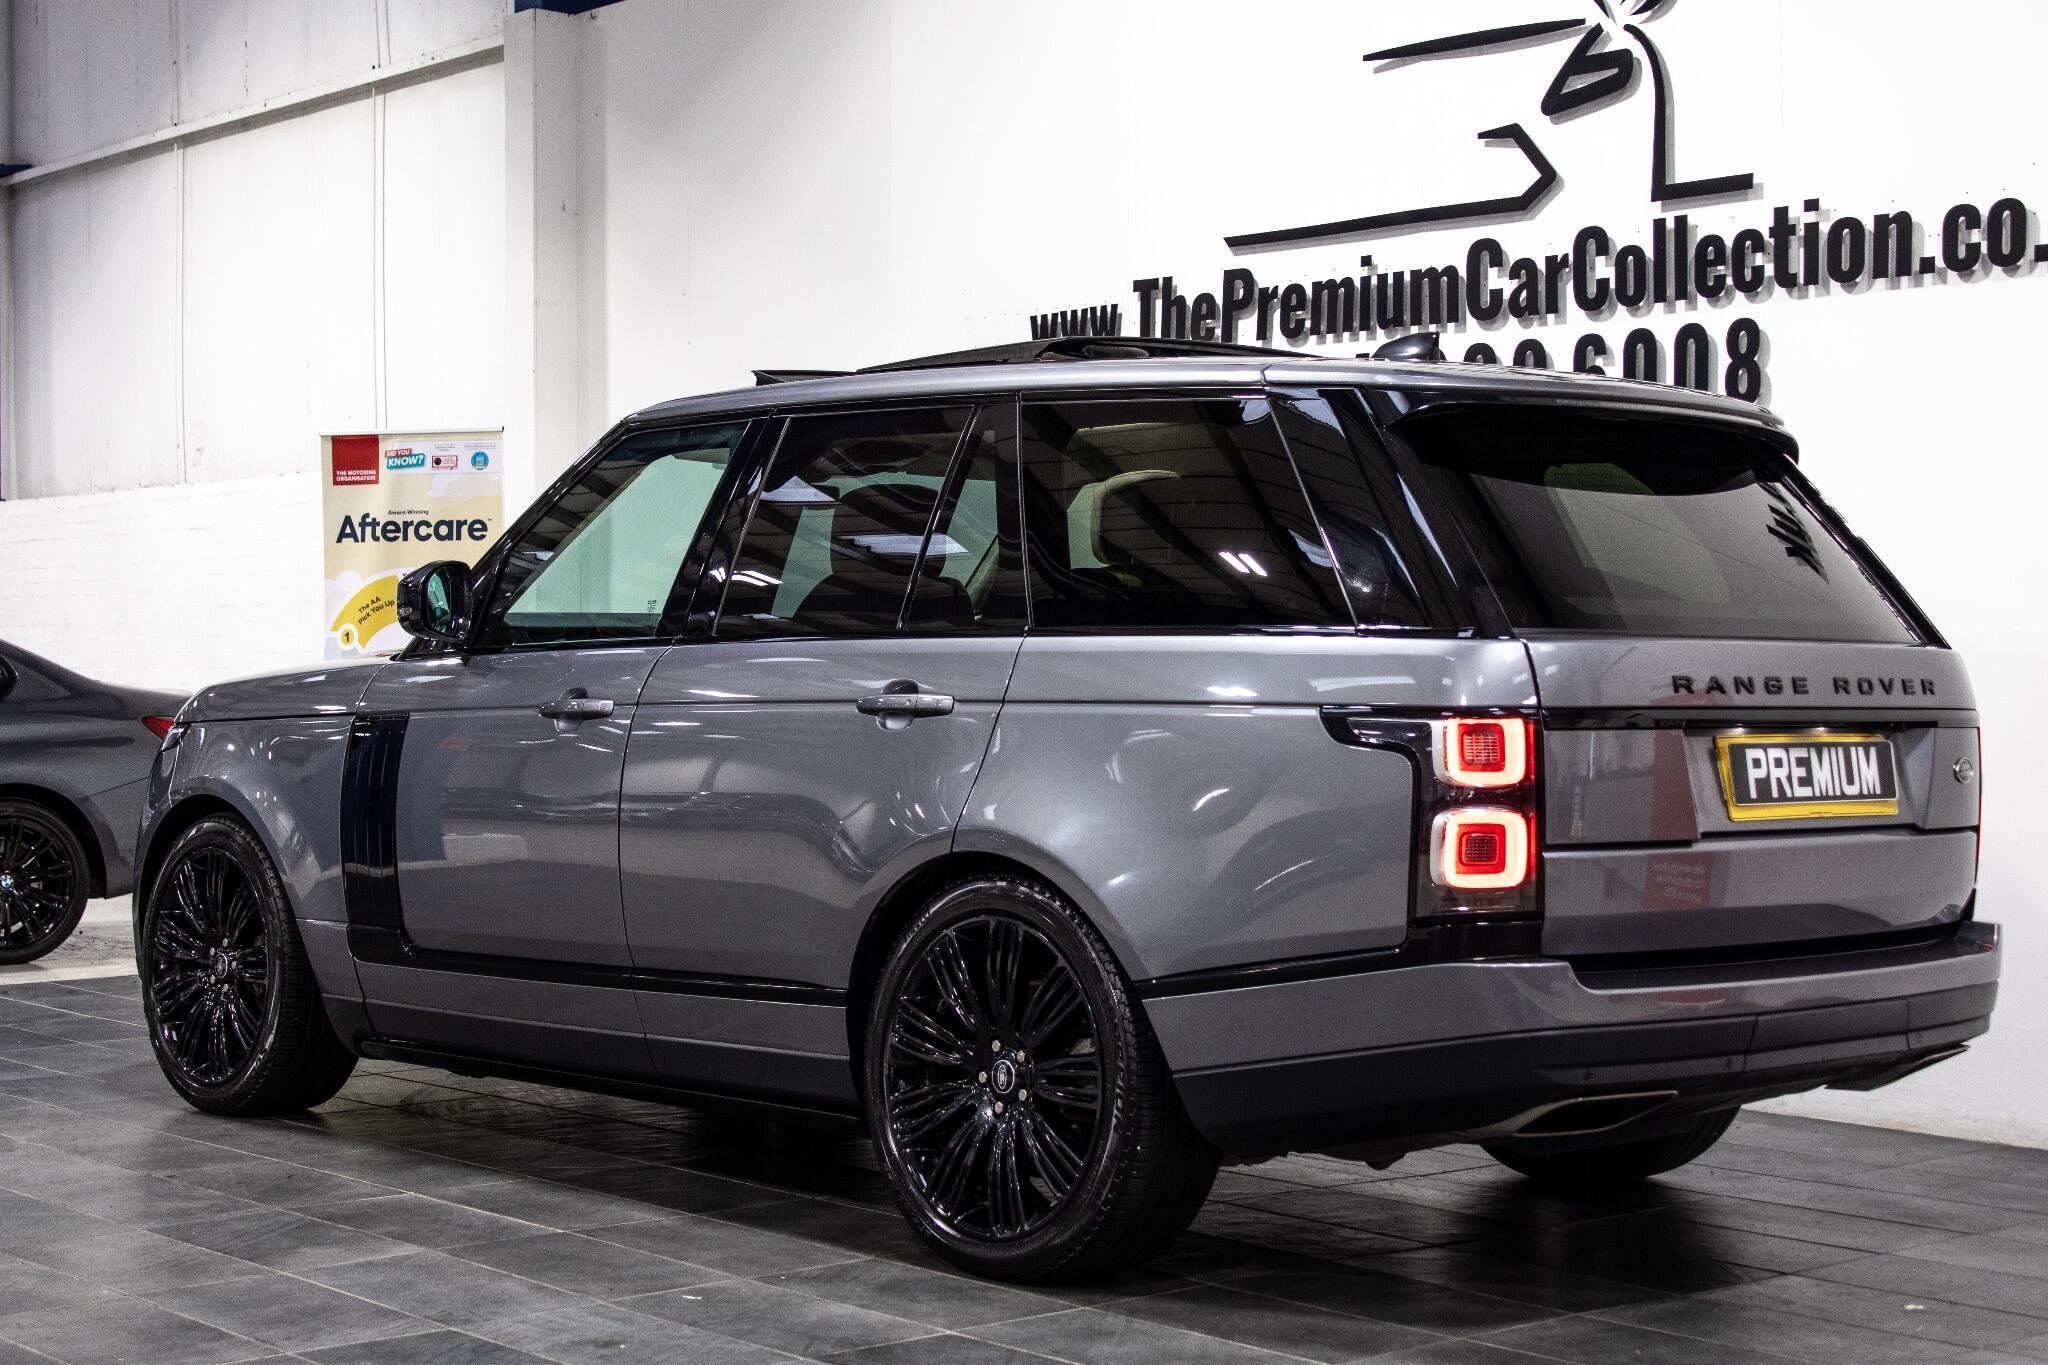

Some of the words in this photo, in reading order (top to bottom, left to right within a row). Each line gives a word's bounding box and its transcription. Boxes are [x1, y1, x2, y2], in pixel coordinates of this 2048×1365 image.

[398, 448, 410, 456] YOU
[388, 454, 424, 467] KNOW?
[336, 512, 488, 544] Aftercare
[358, 603, 370, 614] The
[370, 596, 382, 605] AA
[371, 604, 384, 614] You
[384, 600, 395, 609] Up
[344, 631, 350, 643] 1
[1672, 675, 1810, 695] RANGE
[1832, 676, 1937, 696] ROVER
[1744, 746, 1882, 799] PREMIUM
